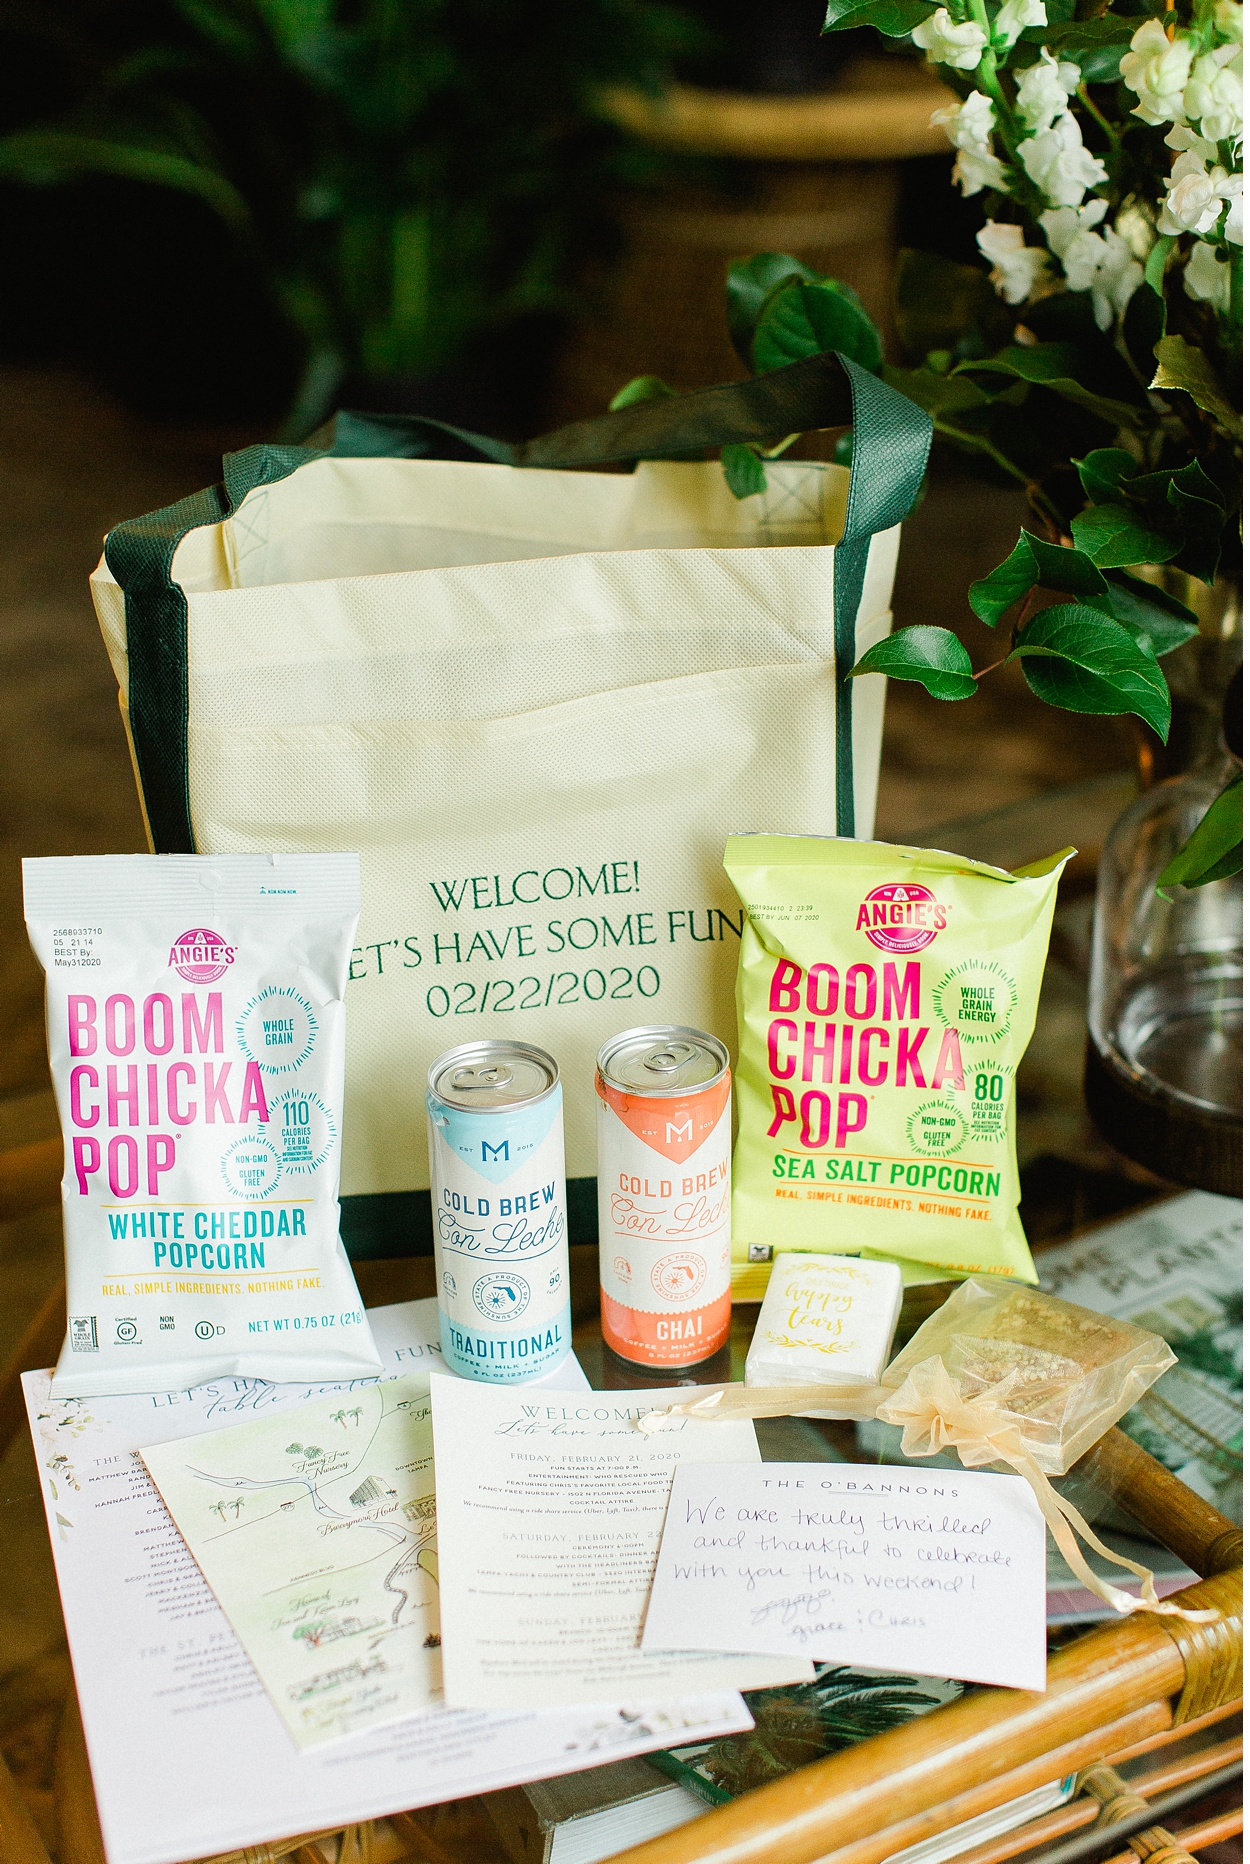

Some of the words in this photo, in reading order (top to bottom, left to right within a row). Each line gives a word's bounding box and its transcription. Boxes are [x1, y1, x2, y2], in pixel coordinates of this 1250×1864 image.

[429, 860, 641, 913] WELCOME!
[855, 903, 947, 931] ANGIE'S
[53, 938, 64, 946] 05
[84, 938, 93, 946] 14
[348, 935, 423, 981] ET'S
[433, 924, 537, 965] HAVE
[546, 912, 658, 954] SOME
[667, 908, 744, 943] FUN
[54, 948, 78, 956] BEST
[80, 948, 93, 957] By:
[167, 946, 235, 967] ANGIE'S
[54, 958, 102, 968] May312020
[426, 965, 661, 1018] 02/22/2020
[768, 956, 922, 1022] BOOM
[960, 986, 995, 1000] WHOLE
[962, 999, 993, 1012] GRAIN
[67, 992, 224, 1057] BOOM
[262, 1018, 295, 1033] WHOLE
[958, 1009, 997, 1023] ENERGY
[265, 1032, 294, 1046] GRAIN
[767, 1017, 966, 1091] CHICKA
[69, 1061, 270, 1128] CHICKA
[974, 1073, 1004, 1102] 80
[282, 1100, 310, 1126] 110
[765, 1082, 869, 1149] POP
[971, 1102, 1004, 1112] CALORIES
[988, 1112, 1002, 1120] BAG
[921, 1116, 956, 1126] NON-GMO
[282, 1127, 311, 1136] CALORIES
[284, 1138, 296, 1146] PER
[298, 1136, 310, 1145] BAG
[666, 1119, 693, 1144] M
[924, 1131, 951, 1140] GLUTEN
[236, 1154, 268, 1164] NON-GMO
[481, 1140, 510, 1162] M
[516, 1143, 534, 1151] 2015
[72, 1133, 176, 1198] POP
[239, 1169, 265, 1178] GLUTEN
[772, 1154, 816, 1178] SEA
[825, 1159, 882, 1182] SALT
[890, 1163, 1001, 1197] POPCORN
[244, 1178, 260, 1186] FREE
[619, 1172, 673, 1198] COLD
[682, 1157, 728, 1196] BREW
[443, 1188, 490, 1216] COLD
[500, 1180, 556, 1216] BREW
[806, 1190, 842, 1203] SIMPLE
[846, 1194, 914, 1212] INGREDIENTS.
[918, 1202, 962, 1218] NOTHING
[964, 1209, 992, 1222] FAKE.
[610, 1192, 666, 1234] Con
[108, 1211, 185, 1240] WHITE
[194, 1208, 307, 1240] CHEDDAR
[438, 1207, 486, 1250] Con
[484, 1205, 564, 1254] Leche
[154, 1241, 266, 1270] POPCORN
[675, 1254, 704, 1268] PRODUCT
[496, 1274, 525, 1289] PRODUCT
[549, 1273, 560, 1287] 90
[654, 1262, 665, 1281] STATE
[102, 1284, 132, 1296] REAL,
[134, 1281, 172, 1294] SIMPLE
[175, 1281, 245, 1294] INGREDIENTS.
[248, 1278, 294, 1294] NOTHING
[296, 1276, 326, 1289] FAKE.
[475, 1281, 485, 1298] STATE
[656, 1283, 690, 1300] SUNSHINE
[786, 1281, 853, 1312] happy
[248, 1320, 270, 1333] NET
[274, 1318, 290, 1331] WT
[294, 1316, 318, 1330] 0.75
[321, 1314, 336, 1328] OZ
[340, 1306, 364, 1327] (21g)
[478, 1302, 511, 1320] SUNSHINE
[788, 1306, 843, 1336] tears
[121, 1327, 133, 1336] GF
[216, 1326, 226, 1336] D
[656, 1314, 703, 1340] CHAI
[450, 1324, 562, 1360] TRADITIONAL
[623, 1338, 658, 1350] COFFEE
[671, 1341, 695, 1350] MILK
[453, 1352, 480, 1367] COFFEE
[533, 1348, 560, 1364] SUGAR
[151, 1386, 220, 1409] LET'S
[394, 1342, 442, 1362] FUN
[202, 1384, 287, 1419] table
[494, 1418, 550, 1438] Let's
[548, 1422, 592, 1437] have
[92, 1455, 122, 1467] THE
[292, 1456, 327, 1473] Fancy
[322, 1449, 350, 1464] Free
[394, 1456, 433, 1472] DOWNTOWN
[510, 1452, 556, 1462] FRIDAY,
[562, 1455, 621, 1463] FEBRUARY
[628, 1454, 644, 1462] 21,
[650, 1452, 681, 1460] 2020
[305, 1460, 350, 1480] Nursery
[406, 1464, 428, 1474] TAMPA
[762, 1480, 805, 1489] THE
[820, 1480, 959, 1498] O'BANNONS
[366, 1502, 400, 1522] Hotel
[473, 1502, 508, 1511] recommend
[686, 1496, 726, 1525] We
[737, 1508, 779, 1523] are
[791, 1508, 866, 1536] truly
[876, 1512, 992, 1536] thrilled
[502, 1532, 572, 1542] SATURDAY,
[578, 1532, 640, 1542] FEBRUARY
[693, 1530, 746, 1550] and
[754, 1534, 870, 1560] thankful
[884, 1544, 902, 1558] to
[917, 1546, 1012, 1568] celebrate
[674, 1561, 728, 1580] with
[738, 1566, 791, 1591] you
[802, 1564, 855, 1585] this
